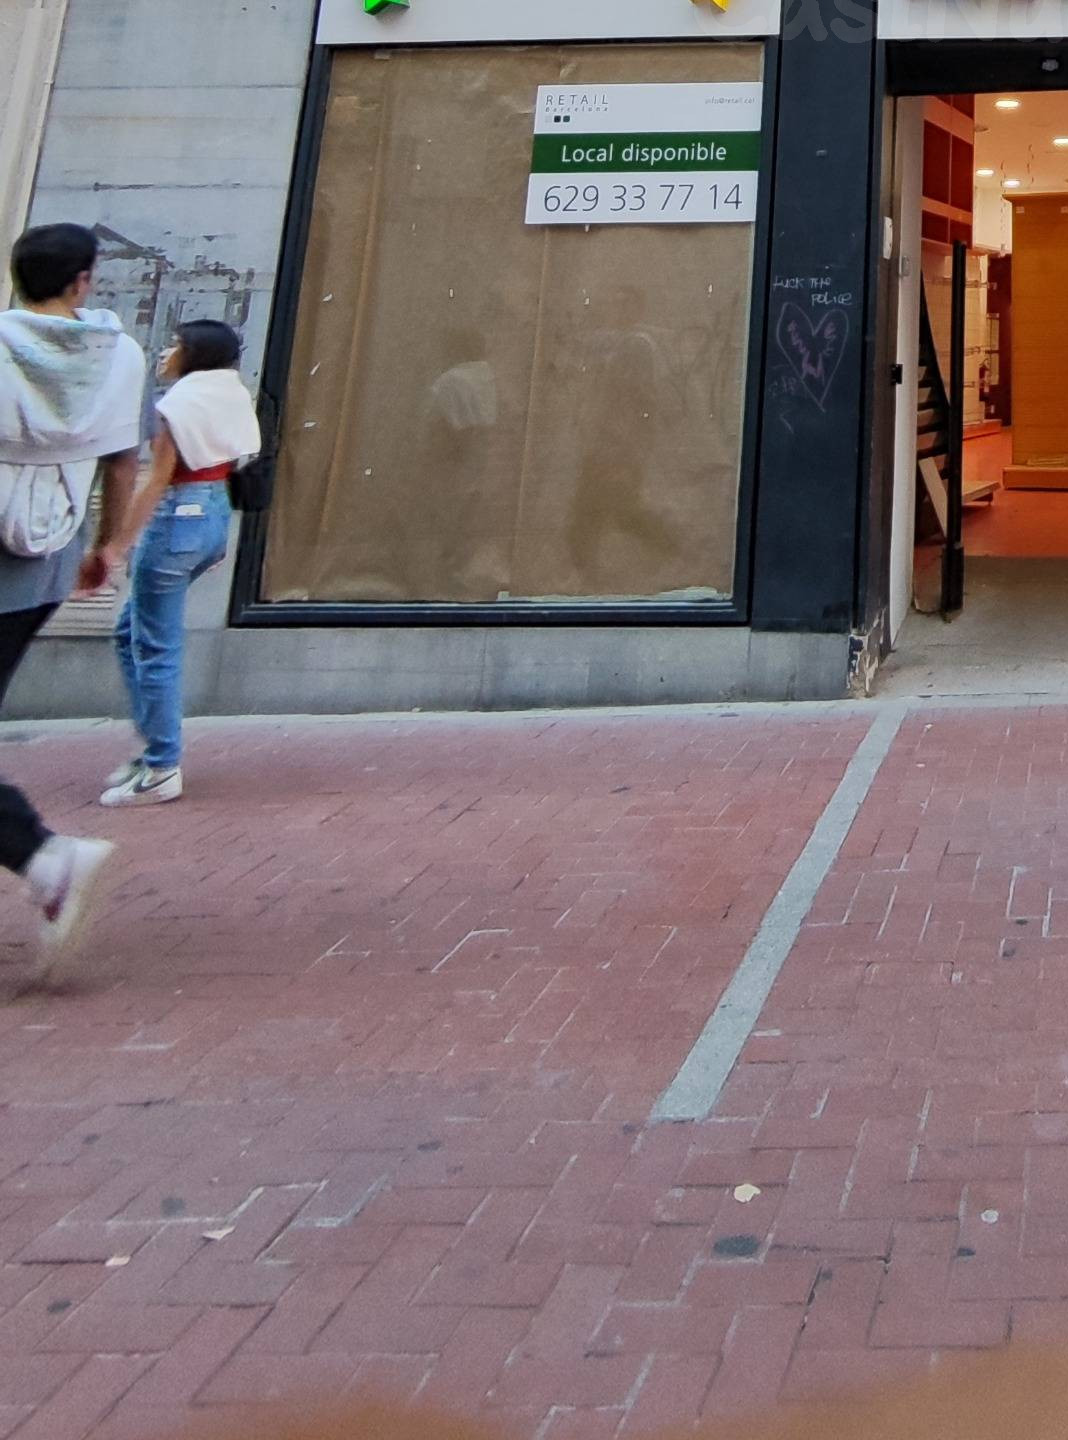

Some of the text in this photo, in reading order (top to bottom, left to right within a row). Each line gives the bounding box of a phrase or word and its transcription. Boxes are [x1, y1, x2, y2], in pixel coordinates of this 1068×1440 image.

[545, 94, 609, 105] RETAIL
[561, 142, 727, 166] Local disponible
[544, 183, 742, 212] 629 33 77 14
